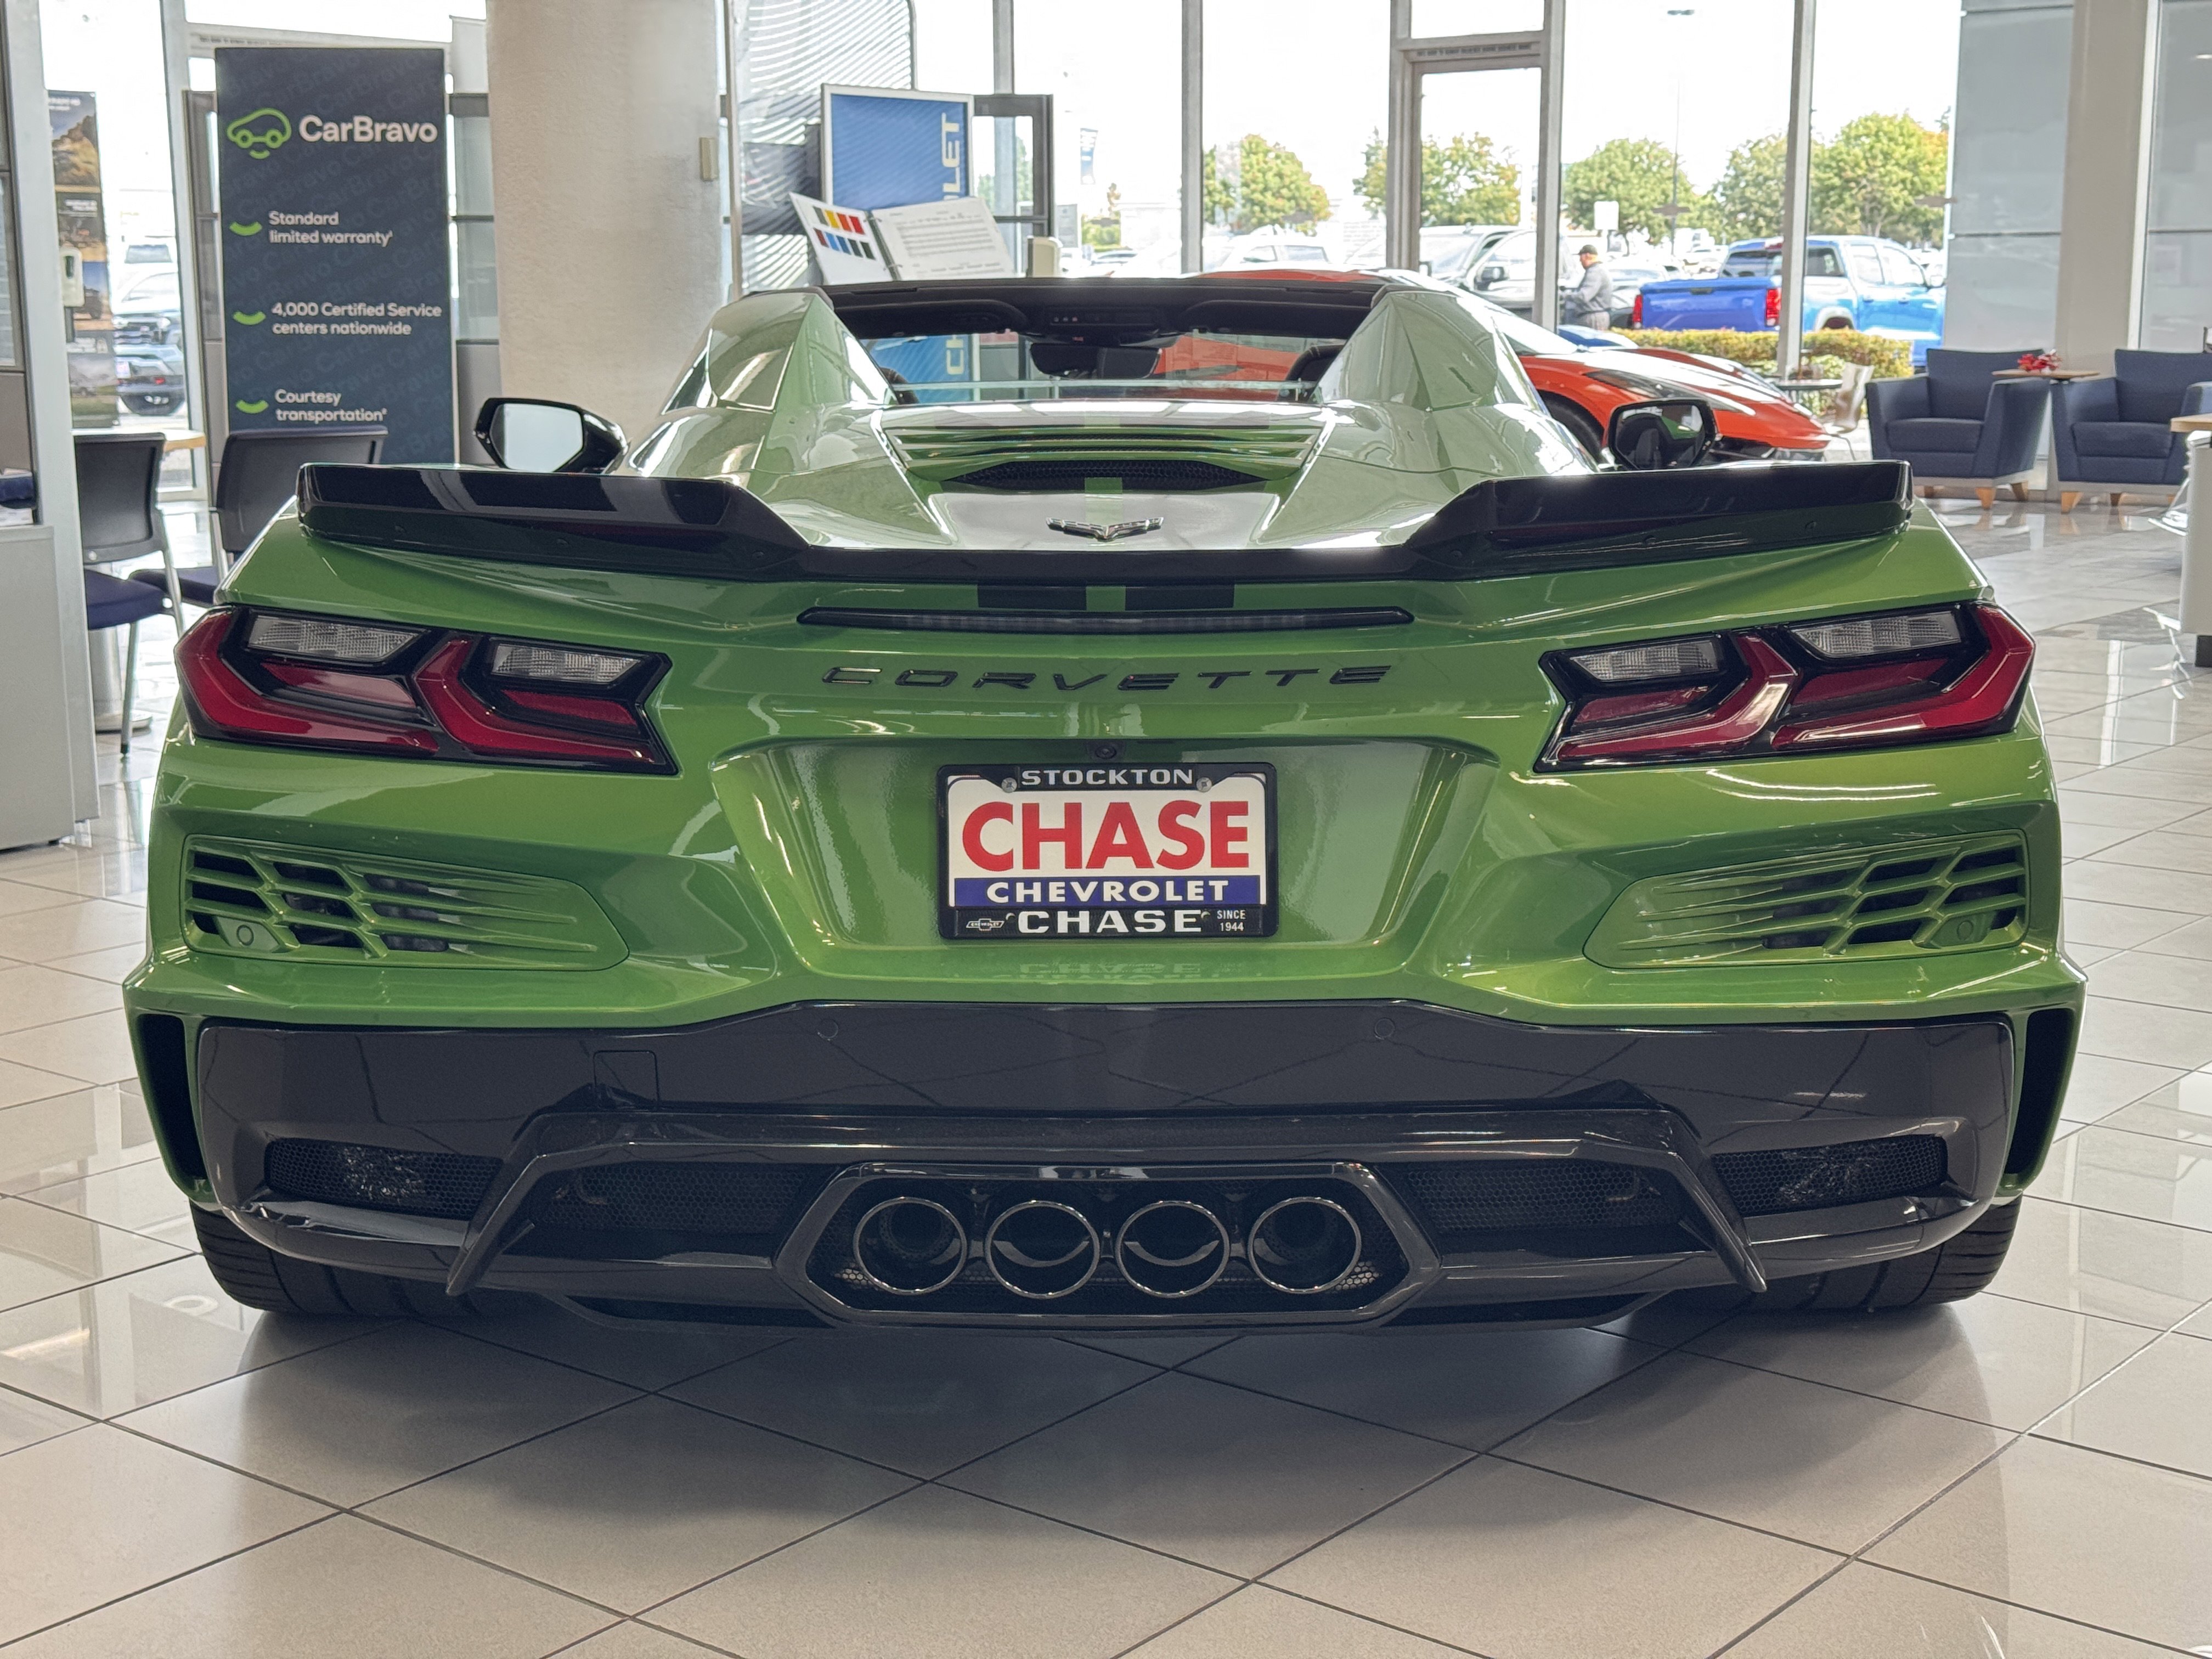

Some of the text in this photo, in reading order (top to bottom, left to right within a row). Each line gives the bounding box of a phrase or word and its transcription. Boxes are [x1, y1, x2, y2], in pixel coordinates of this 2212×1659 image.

[299, 114, 438, 143] CarBravo
[941, 112, 960, 200] LET
[268, 211, 339, 225] Standard
[269, 229, 319, 244] limited
[272, 302, 442, 317] 4,000 Certified Service
[272, 321, 412, 335] centers nationwide
[275, 389, 341, 407] Courtesy
[822, 665, 1391, 691] CORVETTE
[1022, 769, 1193, 785] STOCKTON
[962, 800, 1249, 871] CHASE
[986, 880, 1229, 903] CHEVROLET
[1018, 910, 1202, 933] CHASE
[1217, 910, 1246, 919] SINCE
[1220, 922, 1244, 932] 1944
